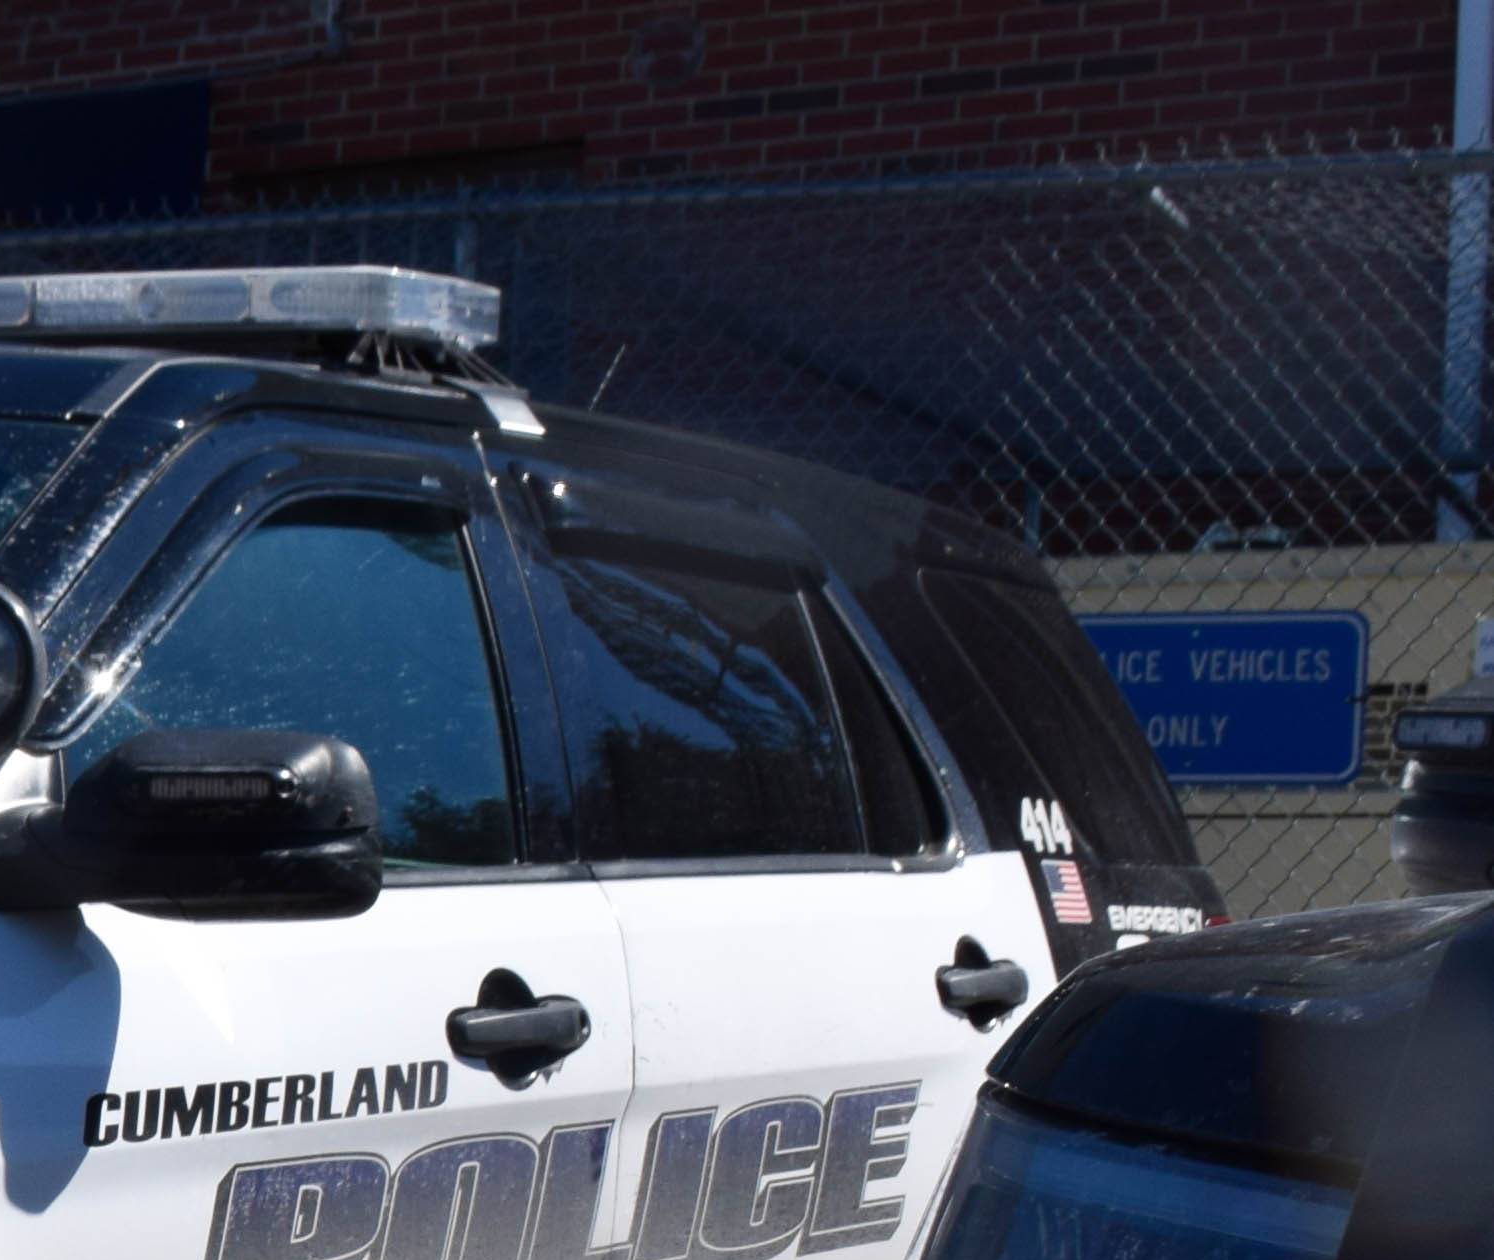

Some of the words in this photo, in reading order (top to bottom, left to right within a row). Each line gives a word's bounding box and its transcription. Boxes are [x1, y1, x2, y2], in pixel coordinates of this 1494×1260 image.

[1190, 648, 1332, 682] VEHICLES
[1147, 715, 1229, 748] ONLY
[1020, 796, 1075, 857] 414
[1107, 903, 1203, 935] EMERGENCY
[84, 1060, 448, 1147] CUMBERLAND
